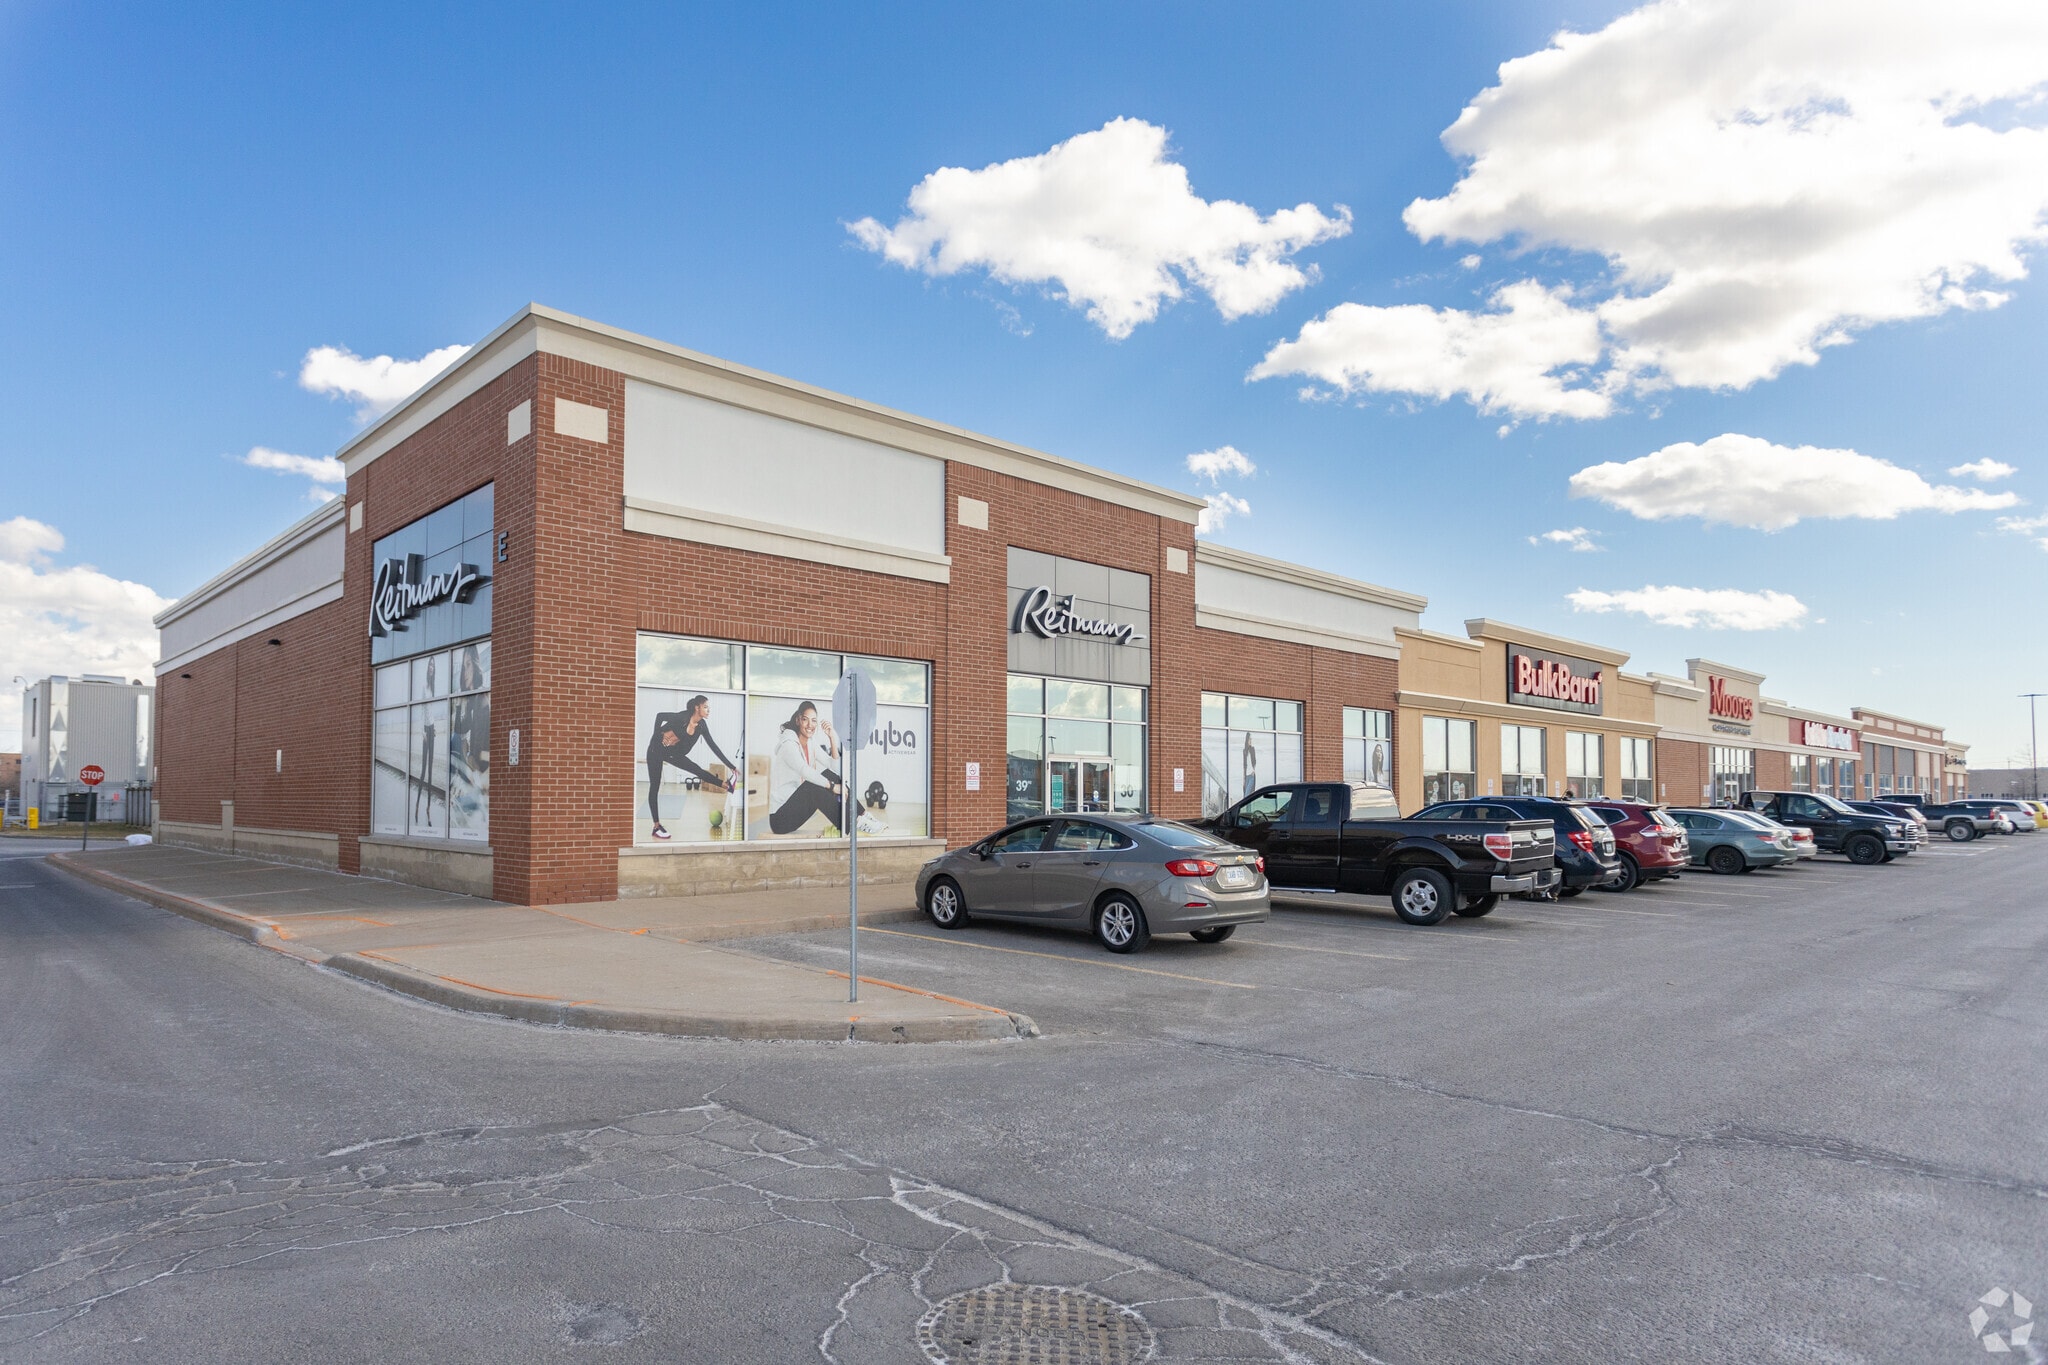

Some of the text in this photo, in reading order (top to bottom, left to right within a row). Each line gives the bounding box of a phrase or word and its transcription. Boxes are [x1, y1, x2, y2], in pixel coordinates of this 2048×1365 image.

[369, 553, 476, 637] Reitmans
[1020, 585, 1147, 645] Reitmans
[1709, 675, 1753, 721] Moores
[81, 770, 104, 780] STOP
[987, 1325, 1086, 1340] DANGER
